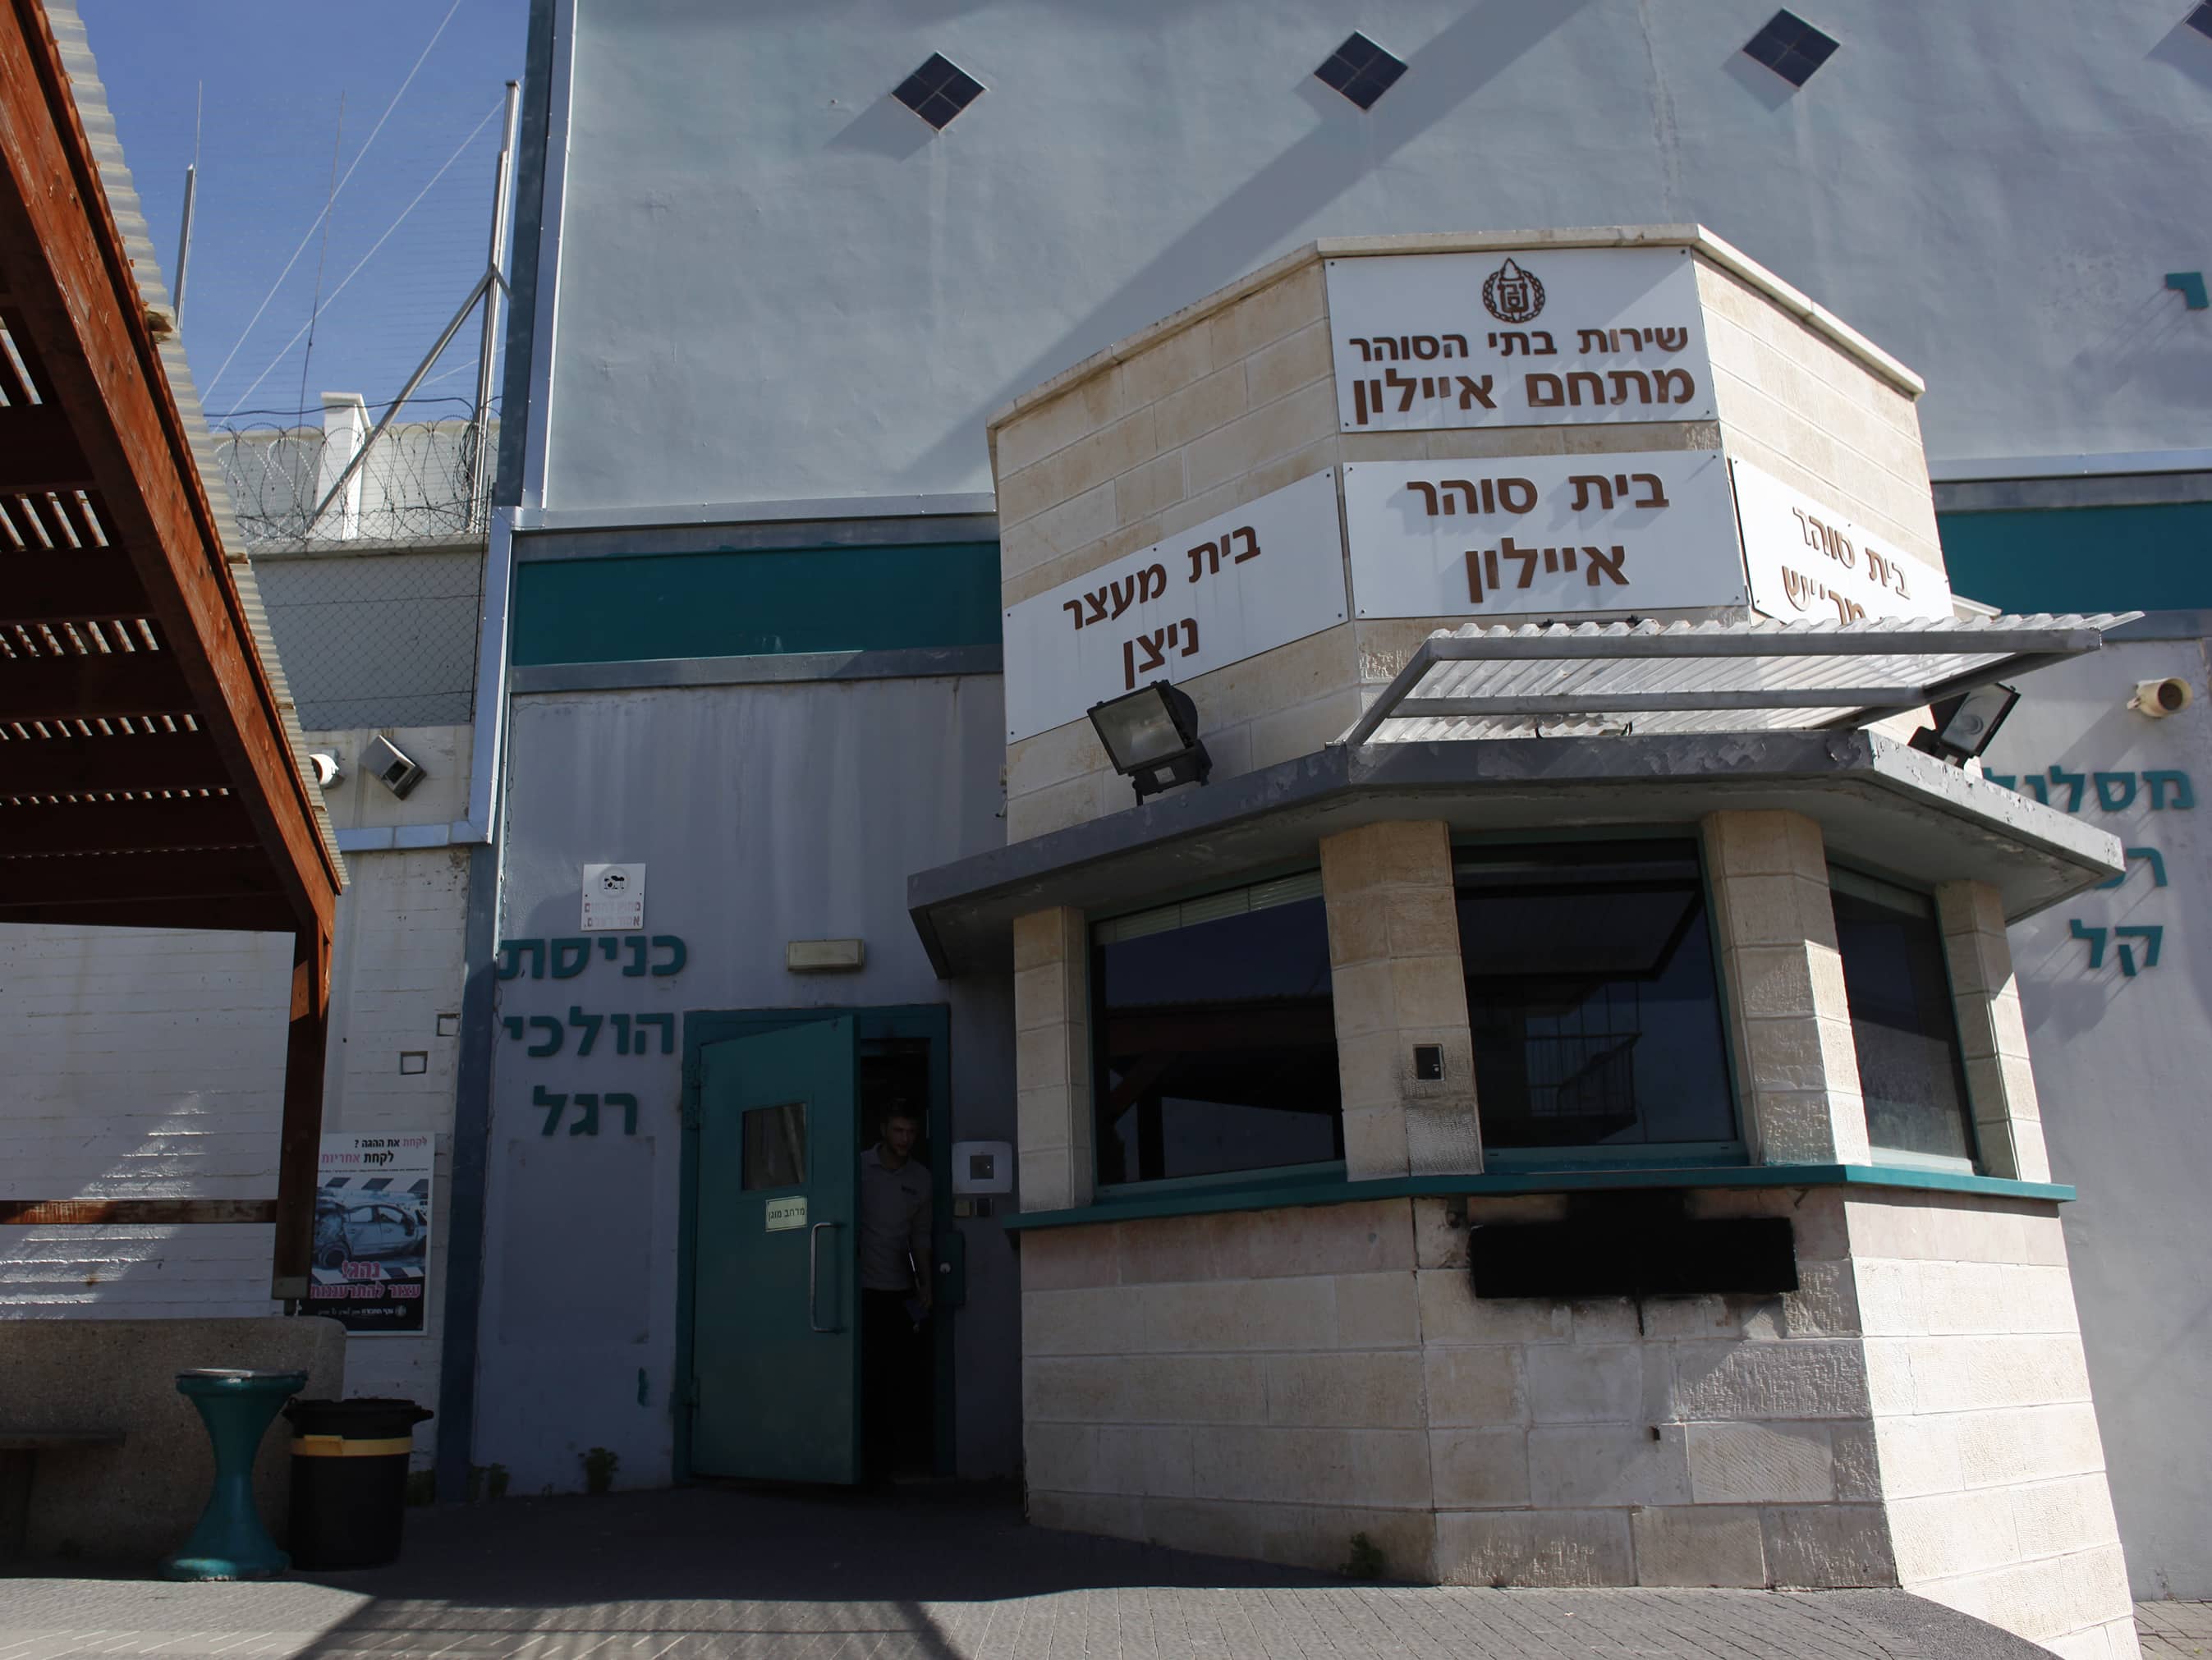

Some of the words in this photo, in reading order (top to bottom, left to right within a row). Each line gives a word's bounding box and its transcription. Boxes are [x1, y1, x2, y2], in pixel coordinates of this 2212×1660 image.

[1349, 333, 1469, 362] הסוהר
[1488, 330, 1558, 356] בתי
[1577, 327, 1689, 354] שירות
[1352, 368, 1498, 425] איילון
[1526, 367, 1696, 407] מתחם
[1407, 476, 1539, 516] סוהר
[1568, 472, 1670, 511] בית
[1186, 525, 1261, 584] בית
[1792, 506, 1856, 569] סוהר
[1465, 537, 1630, 603] איילון
[1865, 547, 1911, 600] בית
[1062, 562, 1167, 631] מעצר
[1122, 617, 1199, 690] ניצן
[498, 935, 687, 980] כניסת
[2069, 919, 2163, 976] קל
[503, 1006, 674, 1057] הולכי
[533, 1085, 638, 1136] רגל
[364, 1150, 394, 1166] לקחת
[387, 1139, 400, 1148] את
[402, 1136, 427, 1149] לקחת
[768, 1209, 782, 1222] מוגן
[784, 1208, 805, 1217] מרחב
